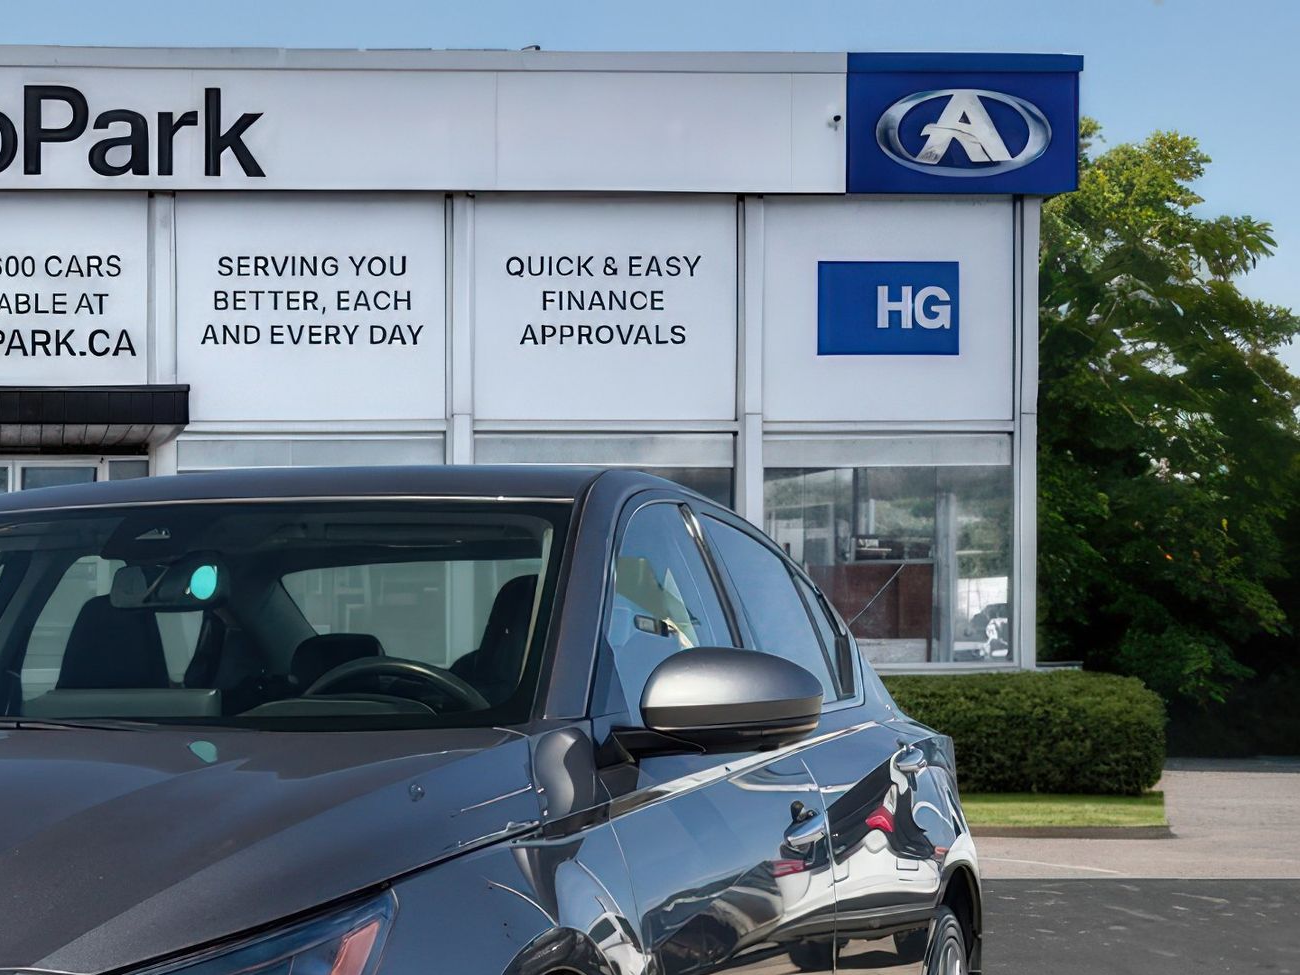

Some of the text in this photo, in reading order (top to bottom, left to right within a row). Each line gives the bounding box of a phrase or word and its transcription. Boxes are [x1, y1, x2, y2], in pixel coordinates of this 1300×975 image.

[44, 254, 122, 279] CARS
[217, 255, 407, 278] SERVING YOU
[505, 254, 703, 278] QUICK & EASY
[74, 292, 110, 315] AT
[213, 289, 412, 316] BETTER, EACH
[542, 289, 665, 312] FINANCE
[876, 285, 953, 330] HG
[200, 323, 425, 346] AND EVERY DAY
[519, 323, 686, 346] APPROVALS
